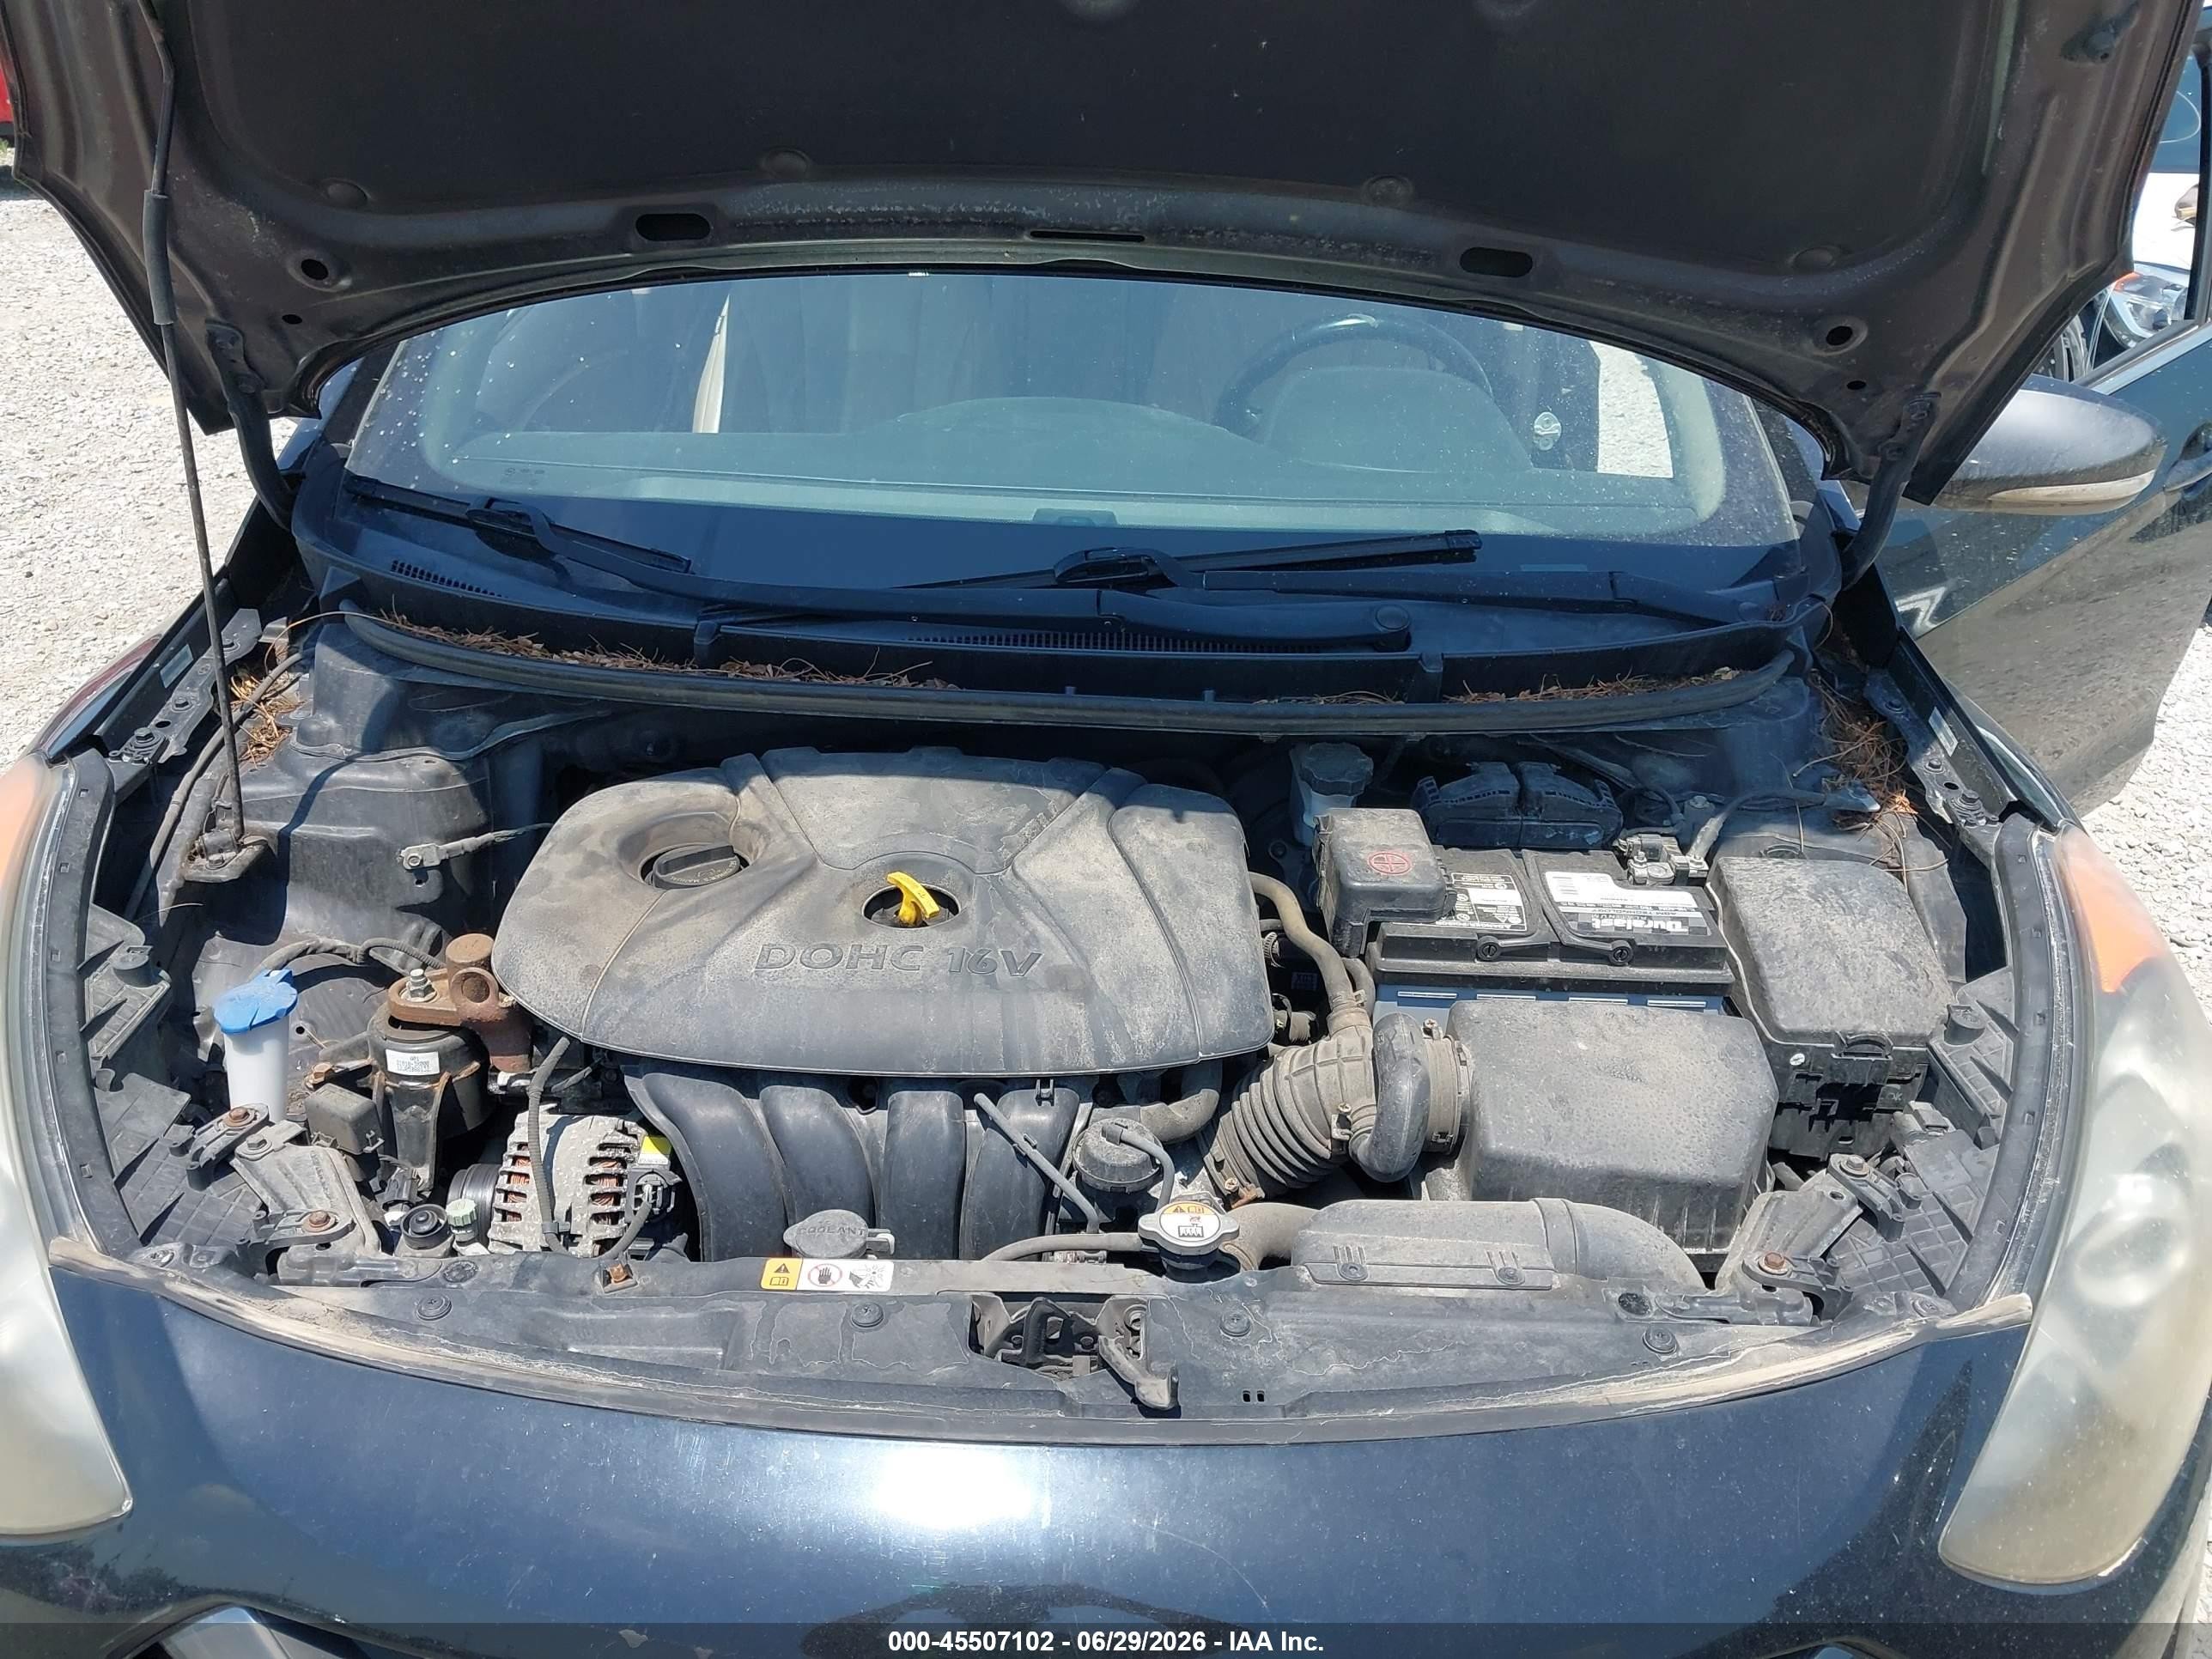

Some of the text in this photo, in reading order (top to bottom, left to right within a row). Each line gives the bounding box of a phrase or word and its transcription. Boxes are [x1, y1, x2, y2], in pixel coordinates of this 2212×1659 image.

[1591, 918, 1689, 933] Duralast
[754, 943, 1043, 977] DOHC 16V
[798, 1224, 866, 1237] COOLANT
